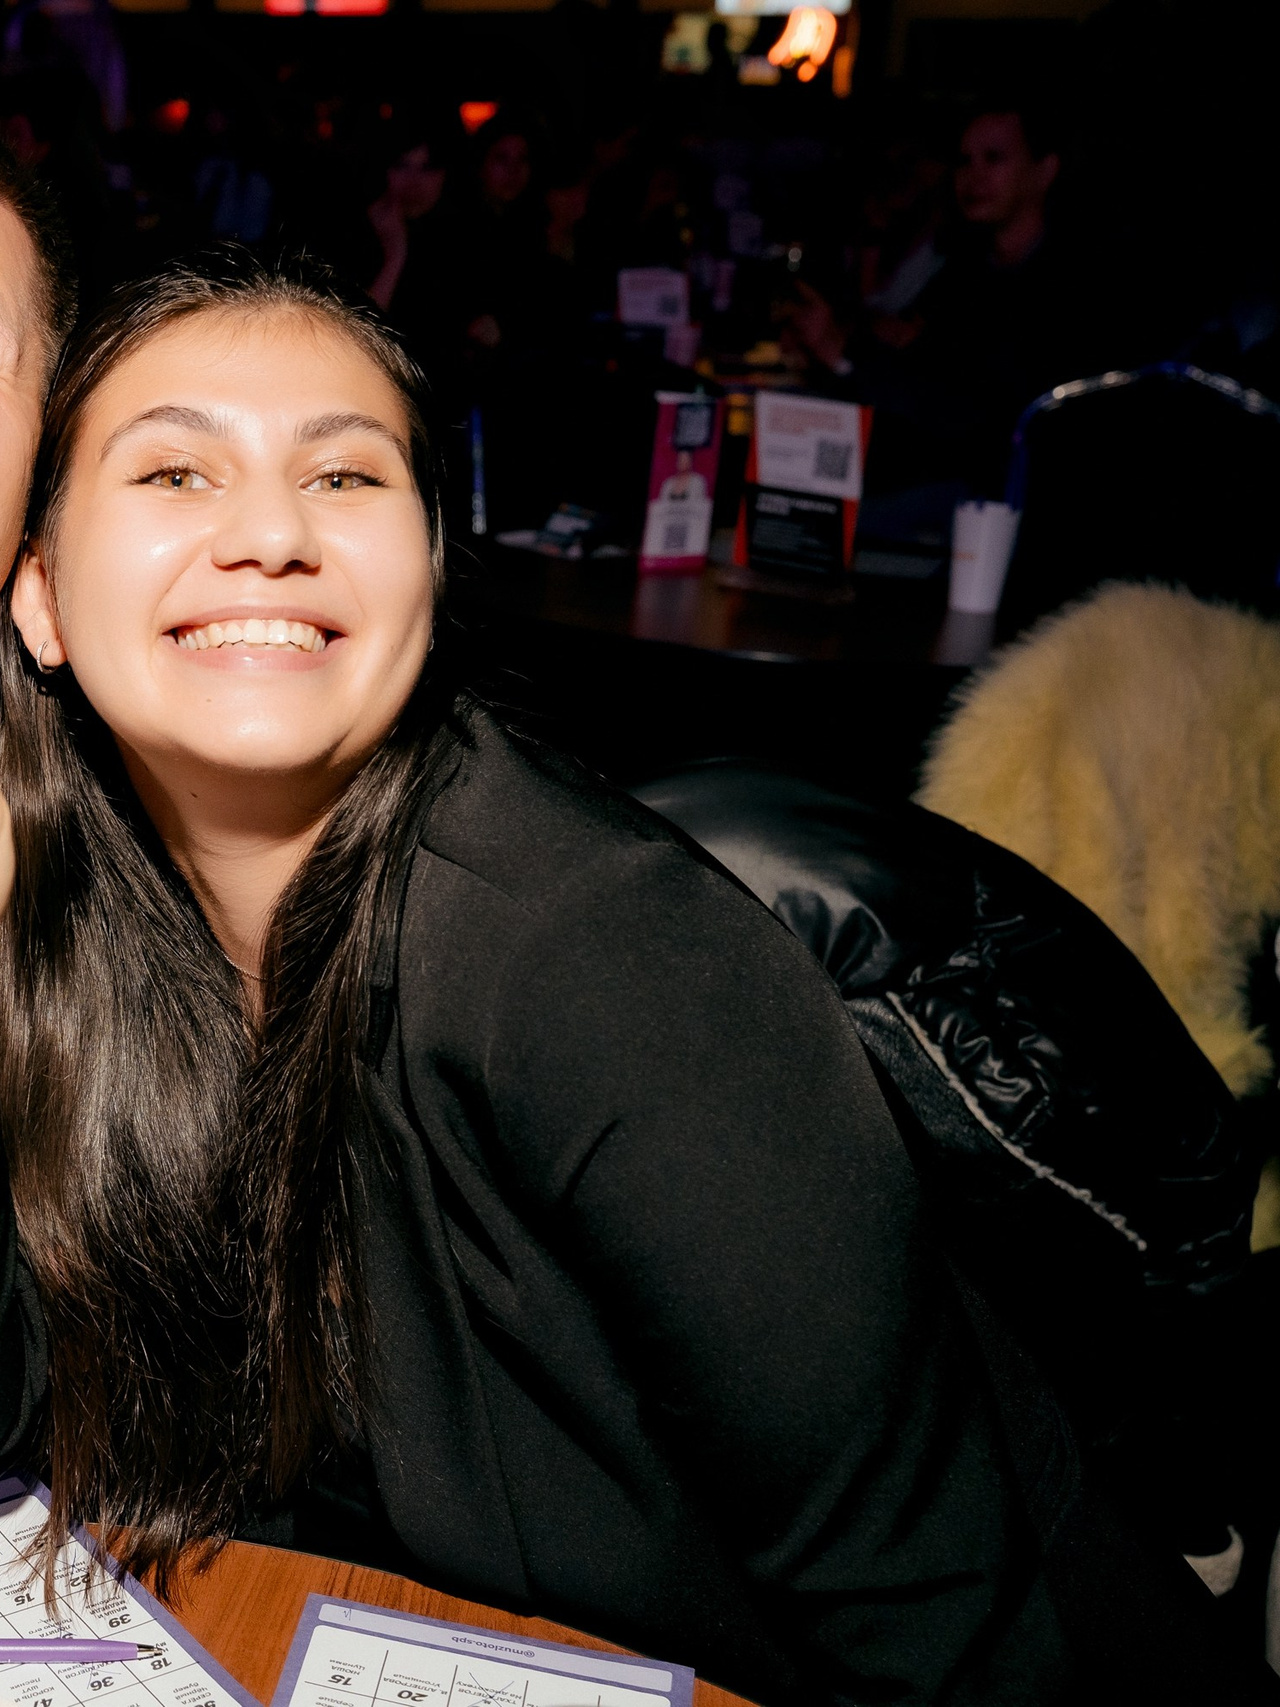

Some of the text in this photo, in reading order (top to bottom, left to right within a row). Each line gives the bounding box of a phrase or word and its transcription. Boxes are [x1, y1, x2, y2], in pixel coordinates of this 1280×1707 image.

[70, 1573, 90, 1587] 22
[14, 1592, 35, 1606] 15
[108, 1613, 132, 1628] 39
[451, 1636, 535, 1658] @muzloto.spb
[150, 1657, 172, 1671] 18
[329, 1659, 365, 1670] Цунами
[331, 1665, 361, 1676] НЮША
[10, 1677, 41, 1690] Лесник
[90, 1676, 115, 1692] 36
[328, 1674, 353, 1686] 15
[383, 1677, 437, 1693] АЛЛЕГРОВА
[393, 1673, 441, 1688] Угонщица
[21, 1685, 39, 1694] ШУТ
[22, 1686, 55, 1700] КОРОЛЬ
[173, 1682, 199, 1693] бумер
[175, 1686, 208, 1700] Чёрный
[455, 1680, 523, 1700] На дискотеку
[181, 1691, 212, 1705] СЕРЁГА
[318, 1696, 355, 1707] сердце
[397, 1690, 428, 1702] 20
